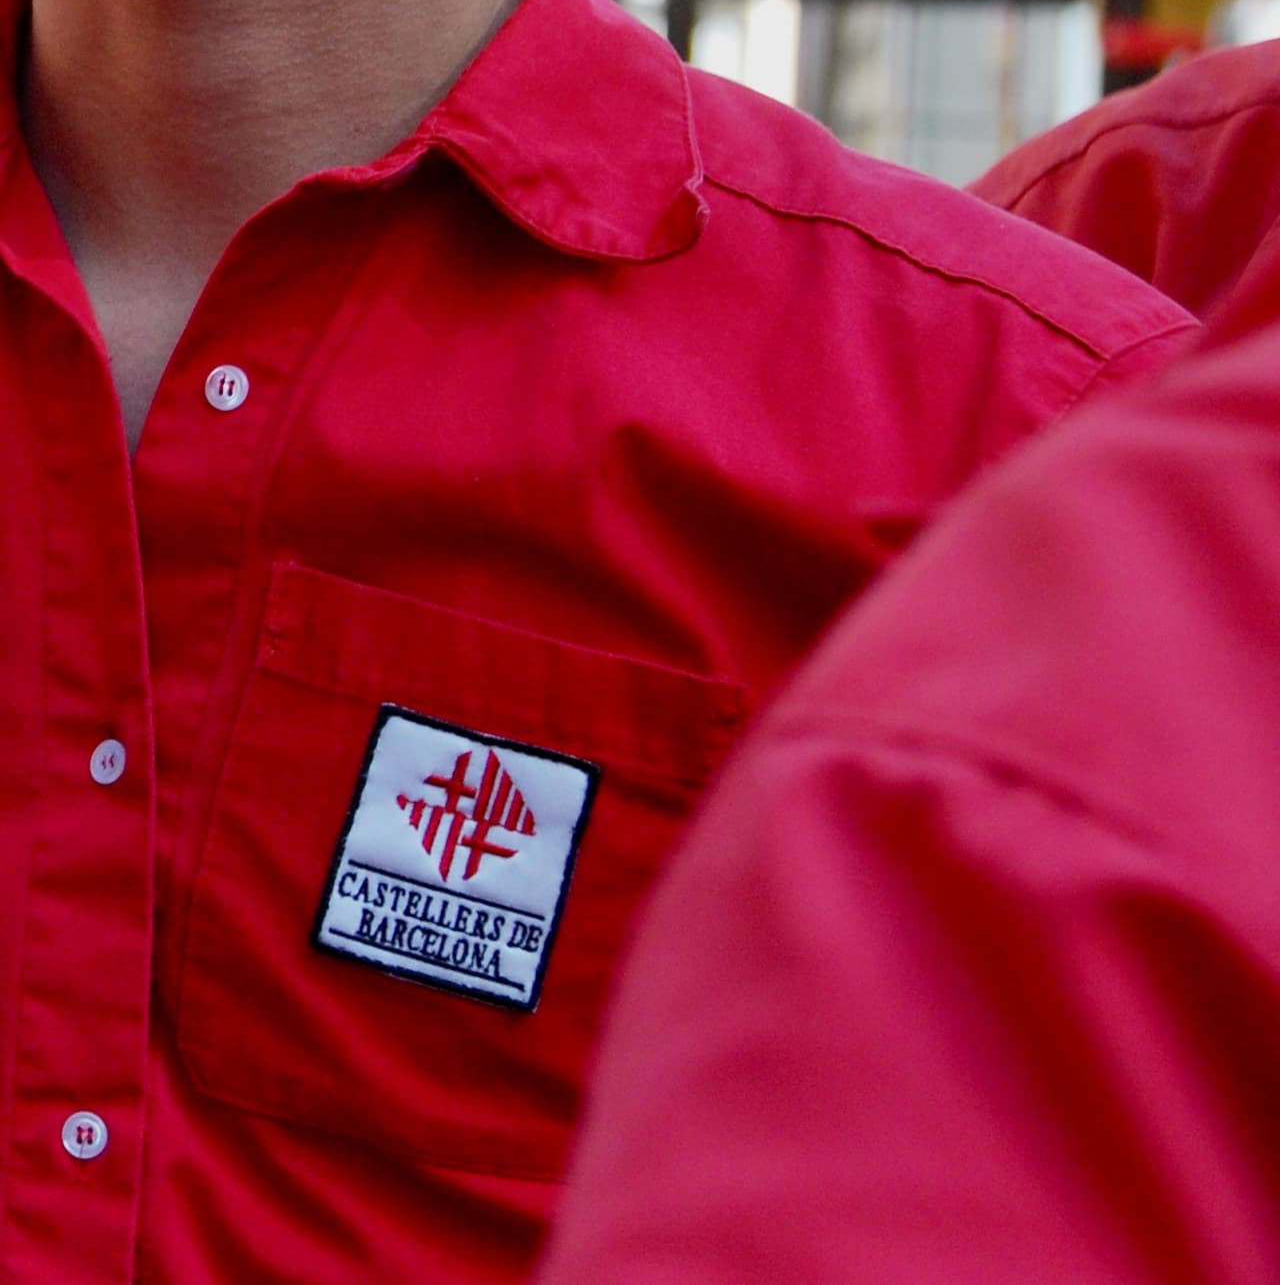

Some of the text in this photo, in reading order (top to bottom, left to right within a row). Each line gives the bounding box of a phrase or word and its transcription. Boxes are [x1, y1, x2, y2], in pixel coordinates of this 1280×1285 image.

[337, 871, 543, 952] CASTELLERS DE
[356, 909, 501, 976] BARCELONA
